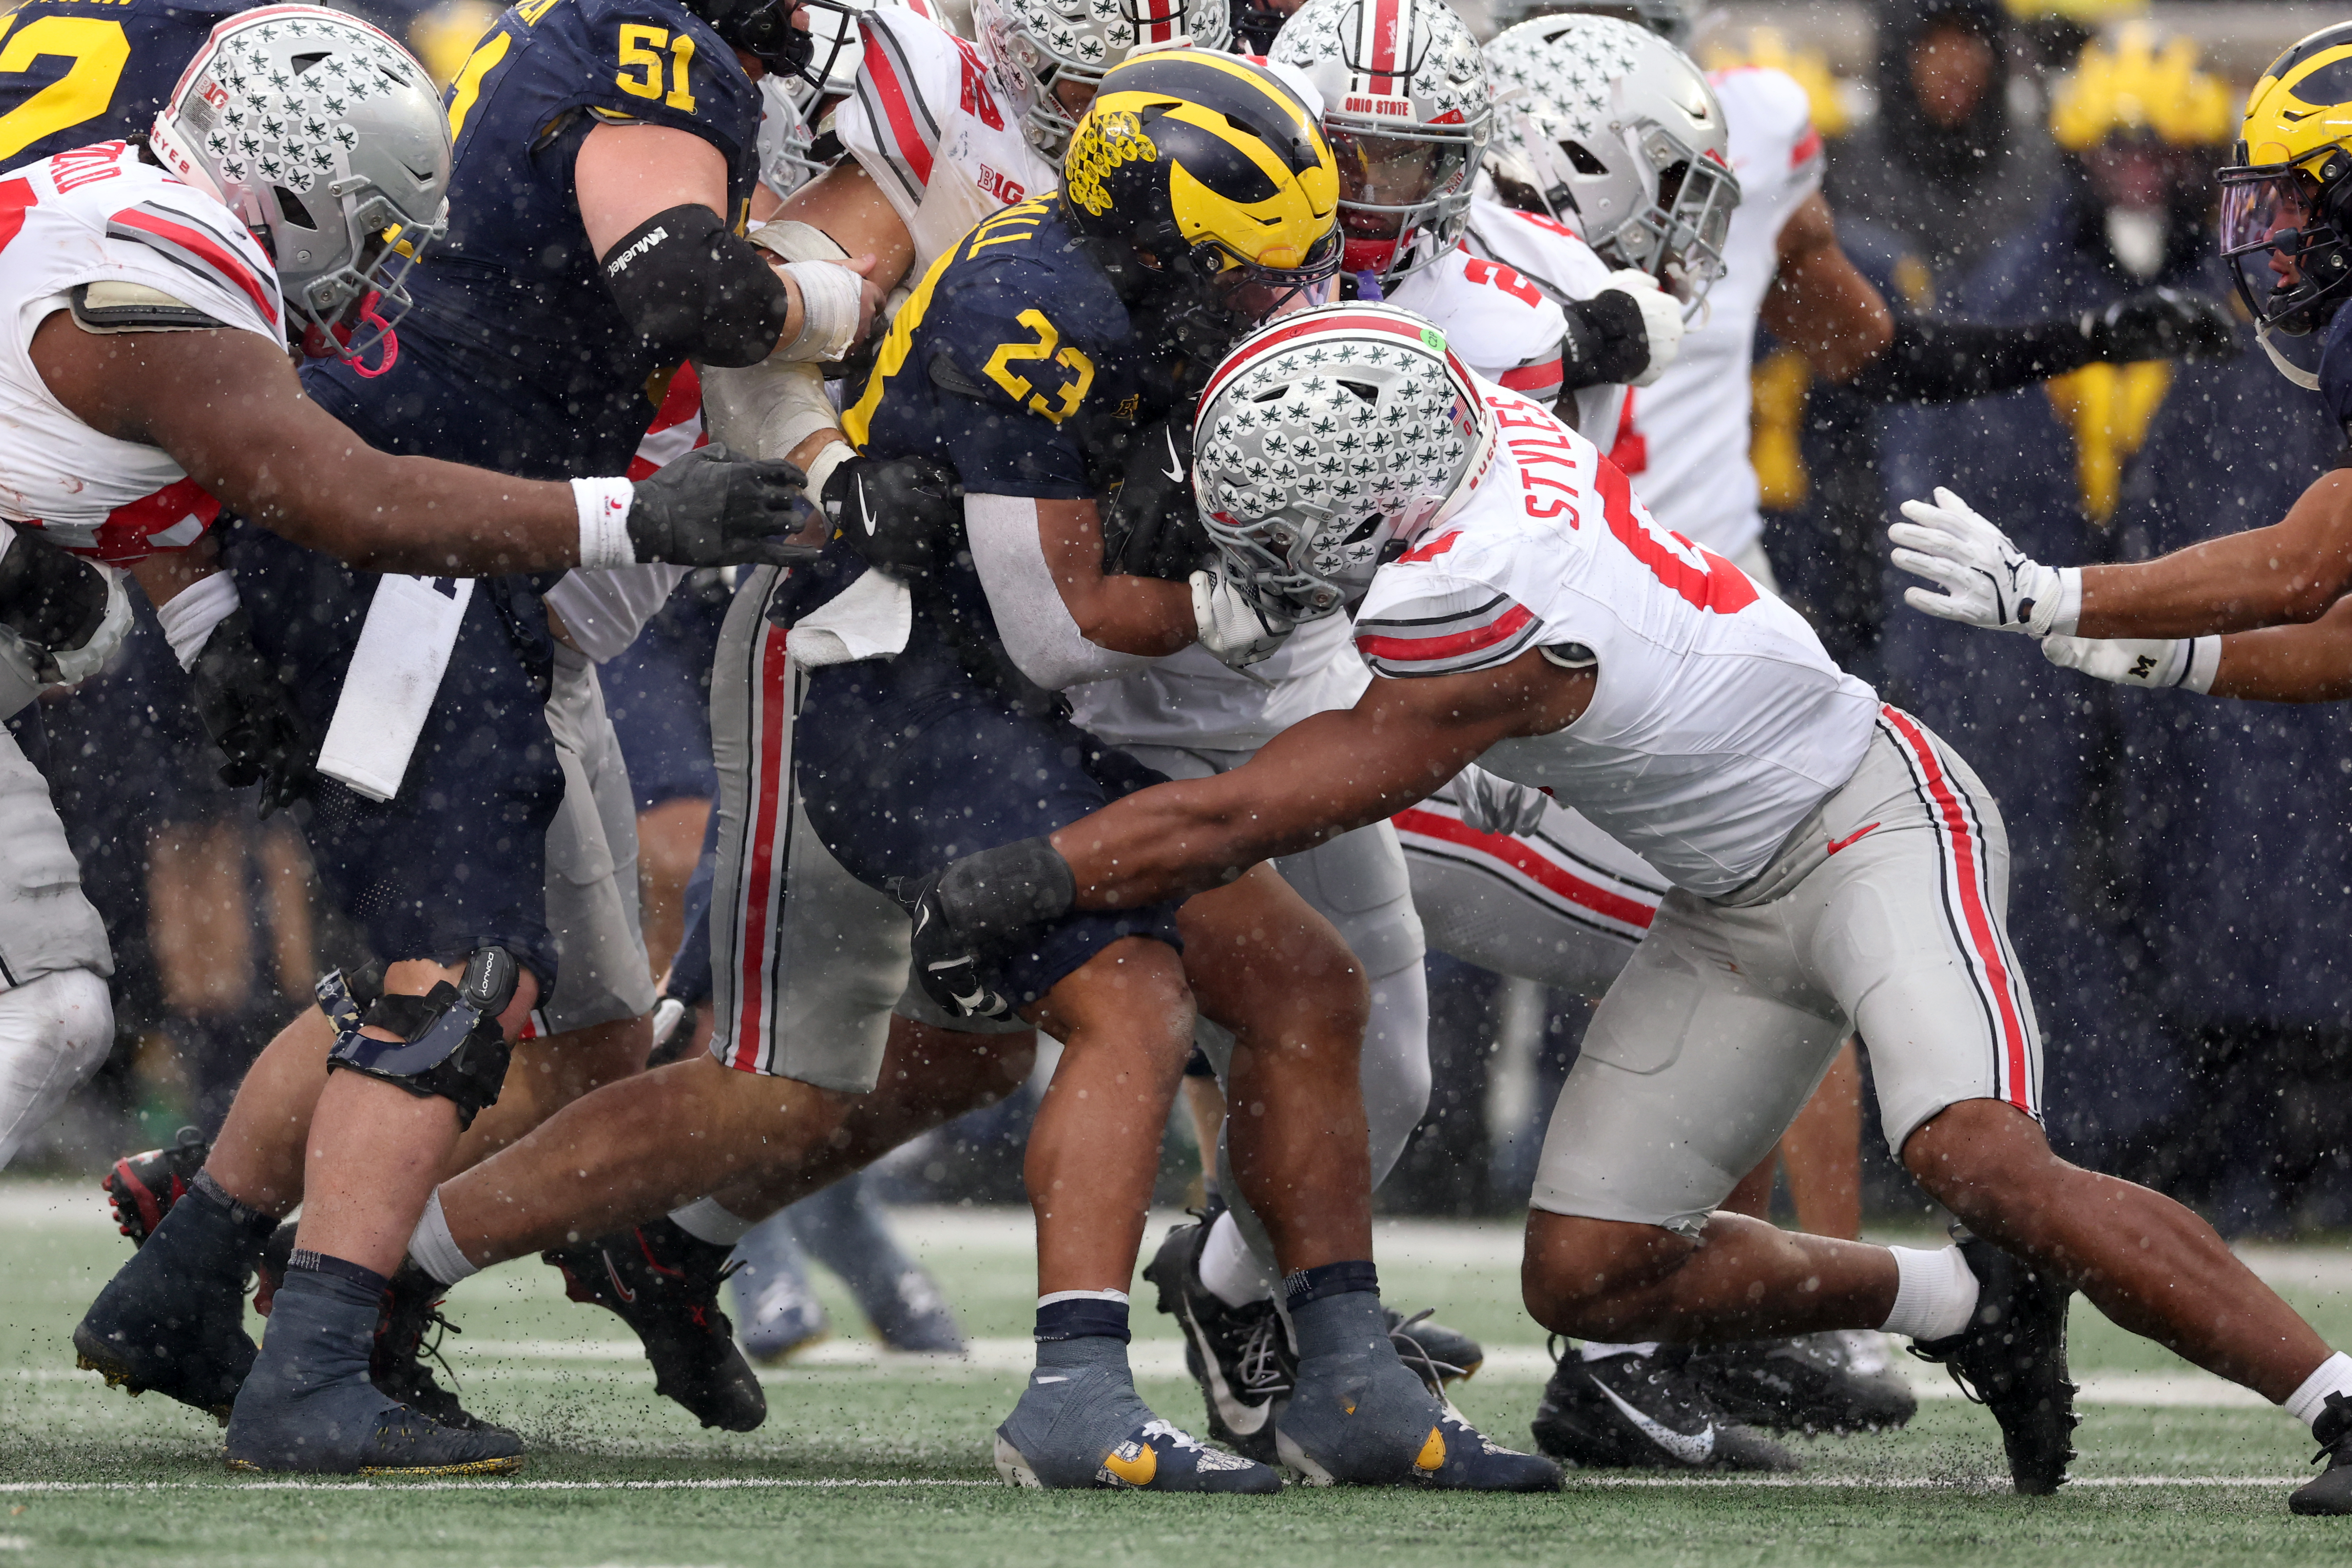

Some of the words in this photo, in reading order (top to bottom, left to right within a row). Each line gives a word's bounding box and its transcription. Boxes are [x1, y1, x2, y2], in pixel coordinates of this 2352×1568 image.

[0, 13, 132, 161] 2
[616, 24, 695, 113] 51
[1346, 97, 1372, 113] OHIO
[1376, 100, 1408, 116] STATE
[607, 233, 659, 278] Mueller
[1464, 258, 1542, 309] 2
[1428, 331, 1437, 348] C2P
[982, 309, 1095, 425] 23
[1485, 396, 1580, 531] STYLES
[2128, 654, 2158, 680] M
[481, 952, 494, 997] DONJOY
